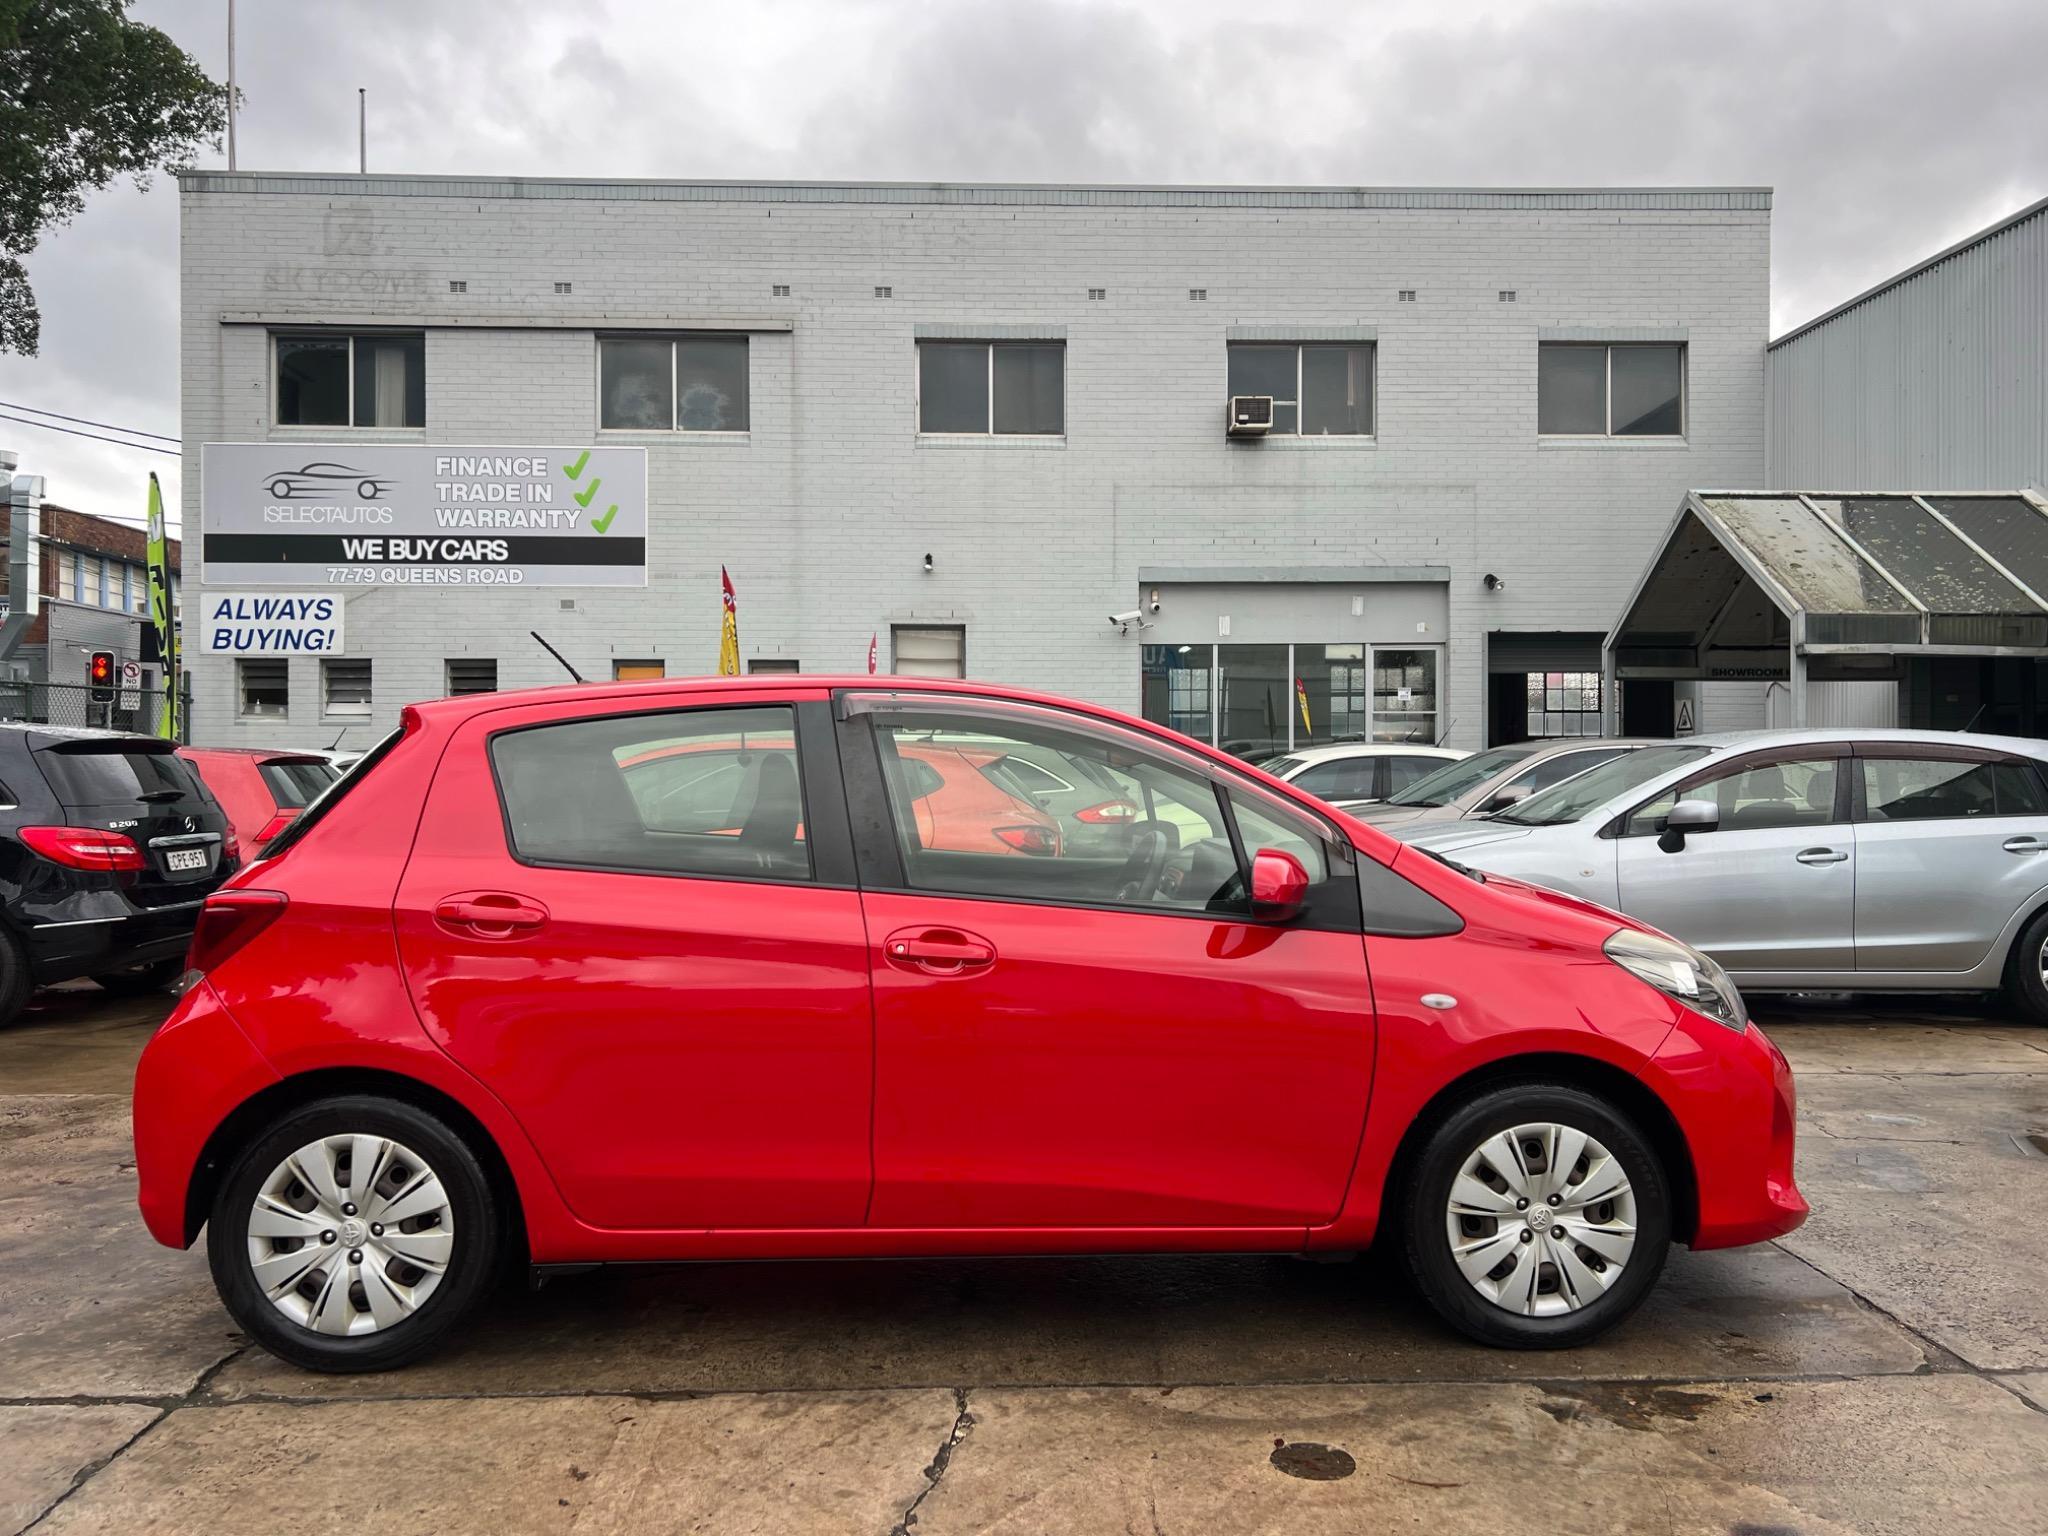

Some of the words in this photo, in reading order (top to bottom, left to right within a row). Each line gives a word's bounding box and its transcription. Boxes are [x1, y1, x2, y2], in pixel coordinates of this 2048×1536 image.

[435, 457, 547, 477] FINANCE
[435, 483, 522, 502] TRADE
[526, 483, 553, 502] IN
[435, 509, 582, 528] WARRANTY
[342, 538, 384, 560] WE
[388, 538, 440, 560] BUY
[440, 538, 509, 561] CARS
[326, 567, 376, 583] 77-79
[380, 568, 462, 584] QUEENS
[466, 568, 524, 584] ROAD
[213, 598, 333, 621] ALWAYS
[211, 628, 335, 651] BUYING!
[1711, 668, 1783, 677] SHOWROOM
[118, 820, 138, 828] 200
